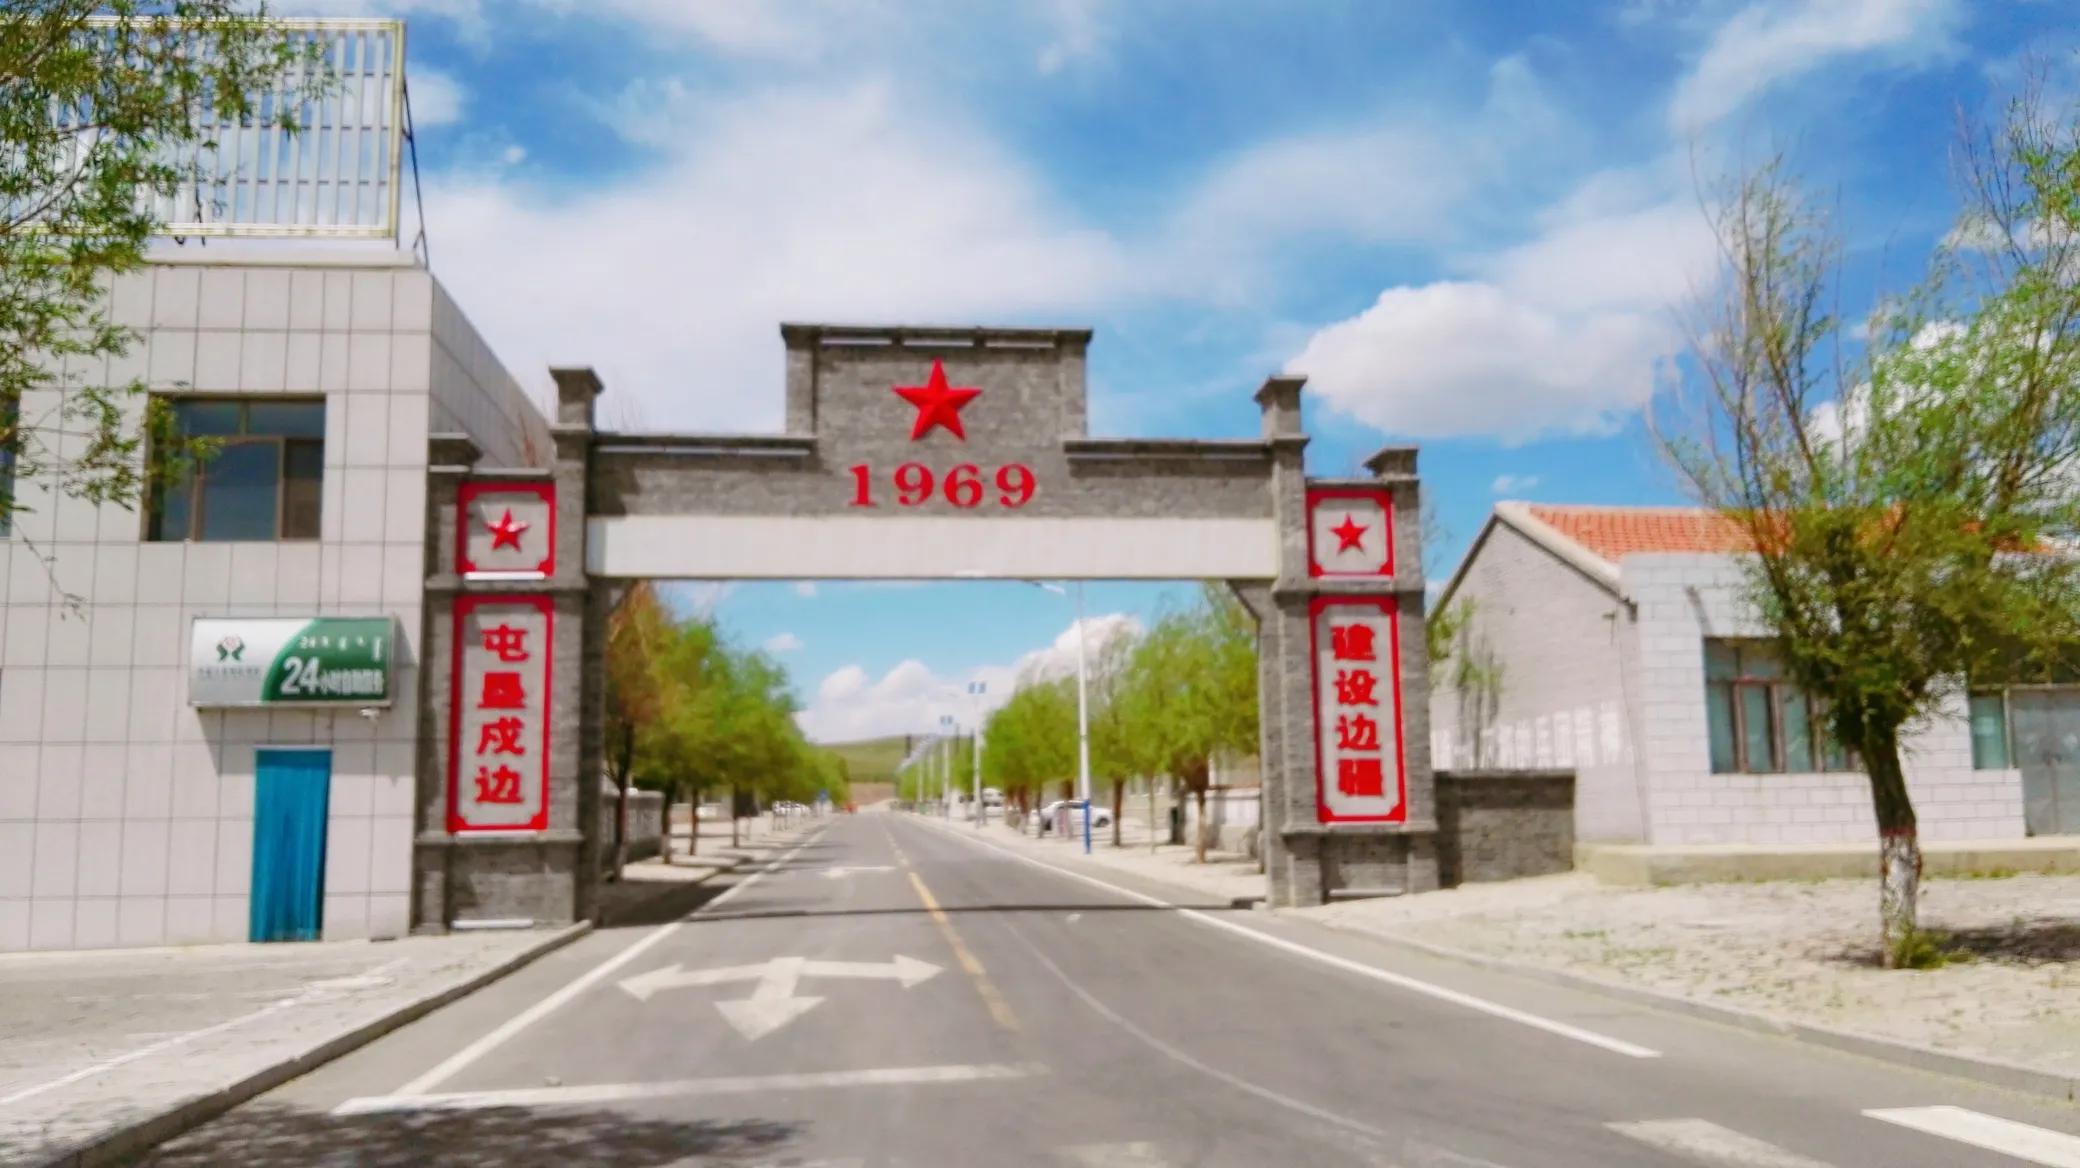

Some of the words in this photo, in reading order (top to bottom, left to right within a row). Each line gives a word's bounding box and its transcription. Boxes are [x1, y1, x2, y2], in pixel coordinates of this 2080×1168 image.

[850, 462, 1037, 508] 1969
[475, 624, 530, 804] 屯垦戍边
[1330, 623, 1384, 797] 建设边疆
